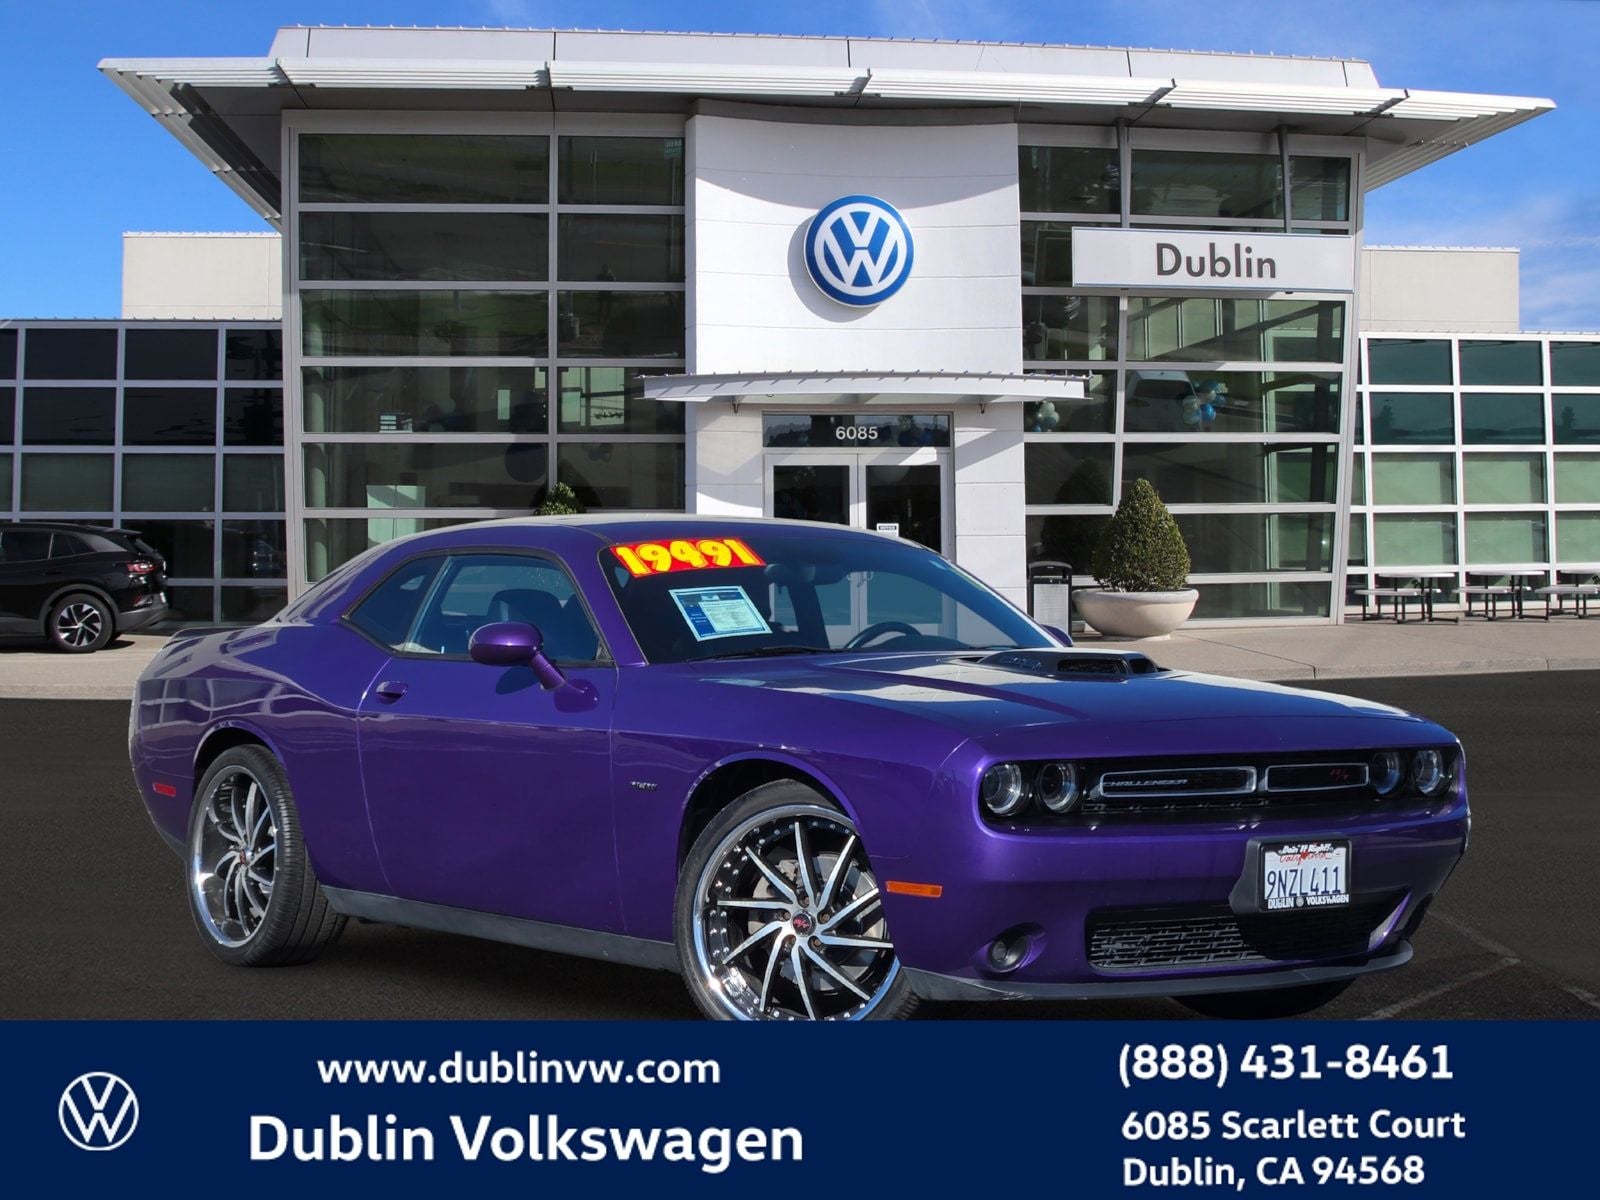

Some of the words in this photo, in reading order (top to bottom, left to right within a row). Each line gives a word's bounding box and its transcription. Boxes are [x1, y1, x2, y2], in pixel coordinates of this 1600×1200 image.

[1156, 242, 1276, 278] Dublin
[835, 425, 879, 440] 6085
[615, 538, 760, 575] 19491
[1103, 779, 1188, 787] CHALLENGER
[1280, 851, 1328, 865] Califrnia
[1267, 866, 1341, 899] 9NZL411
[1267, 897, 1294, 909] DUBLIN
[1306, 894, 1349, 906] VOLKSWAGEN
